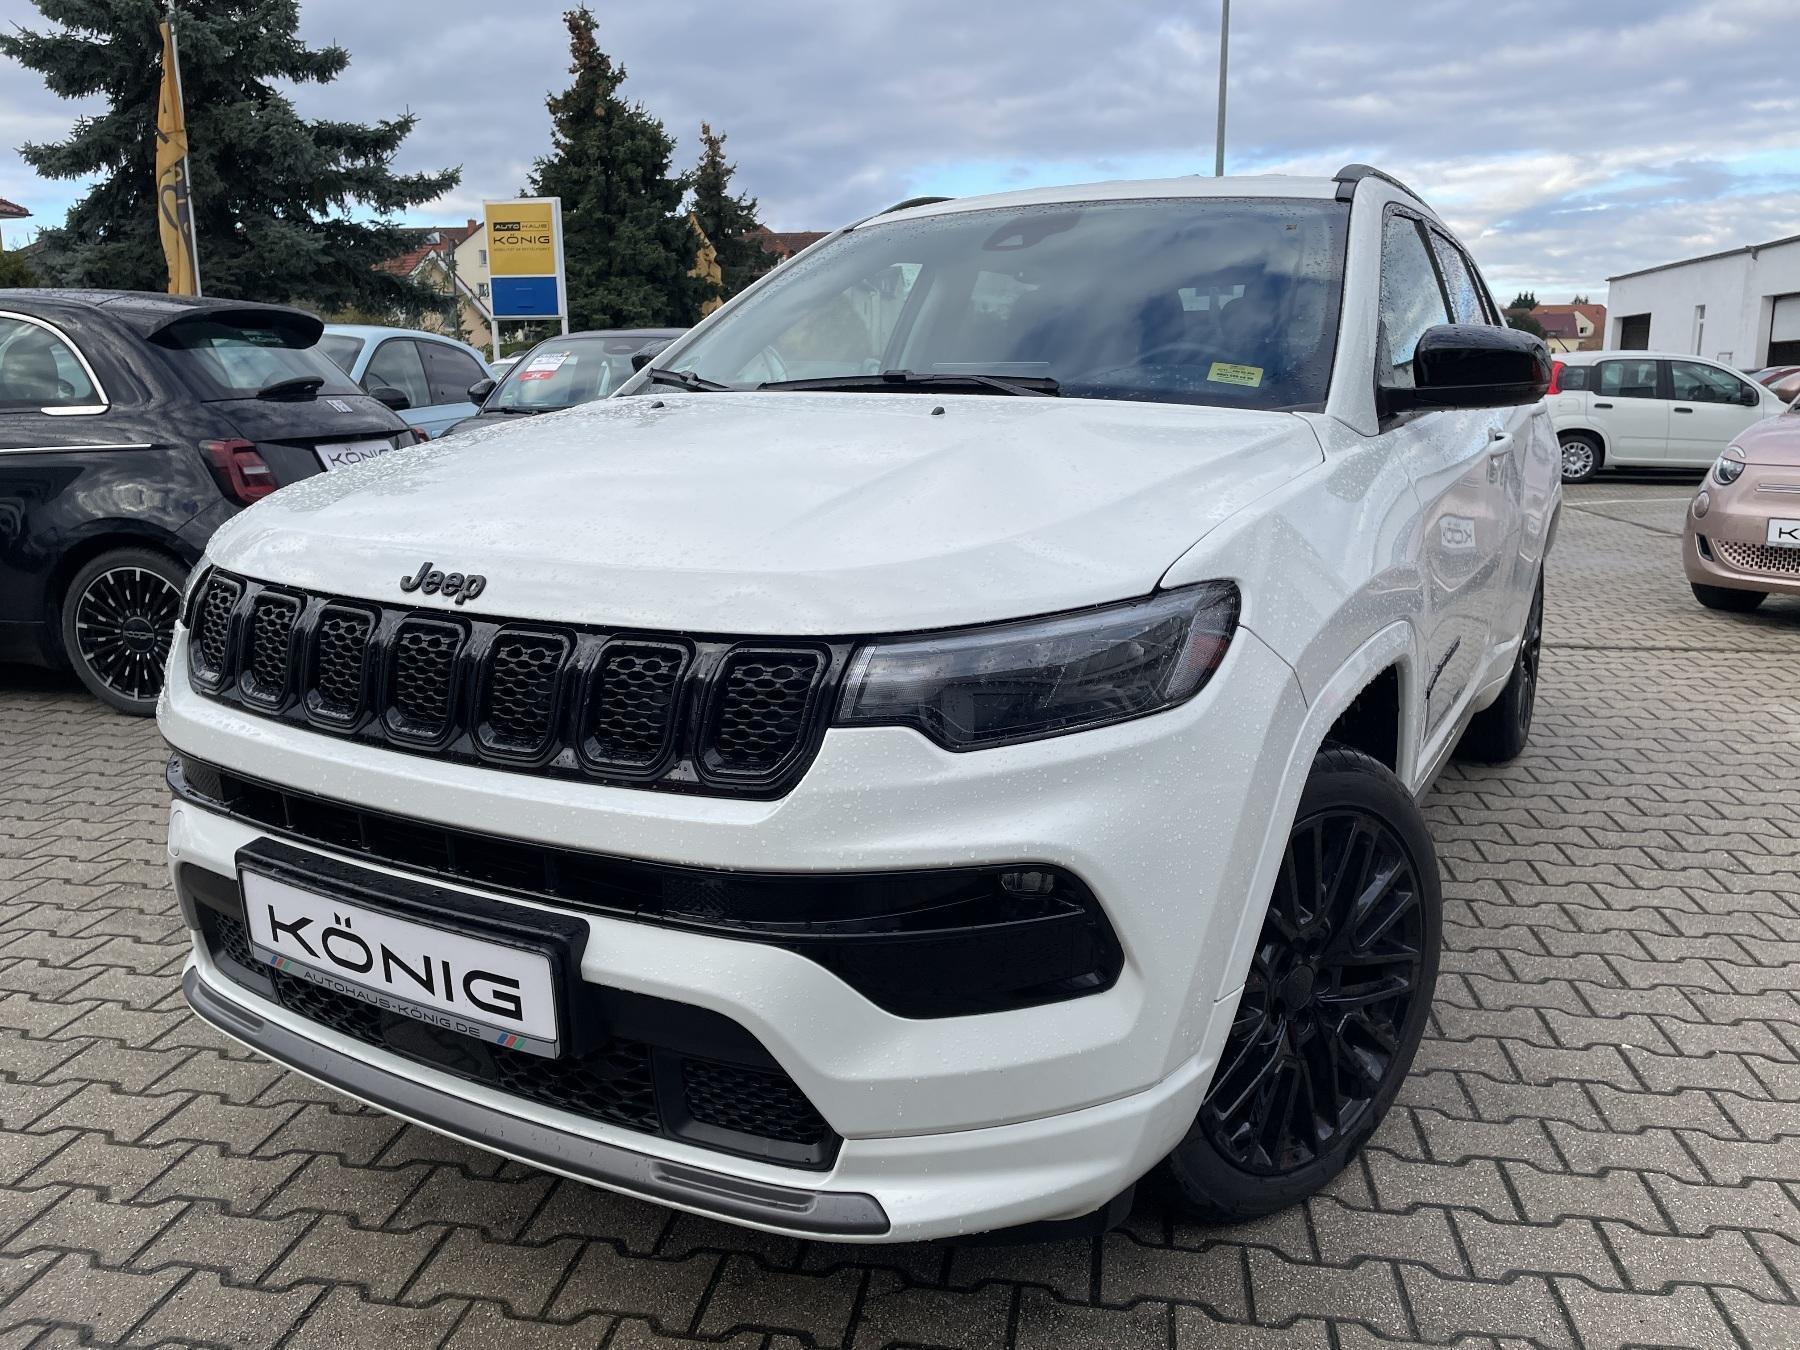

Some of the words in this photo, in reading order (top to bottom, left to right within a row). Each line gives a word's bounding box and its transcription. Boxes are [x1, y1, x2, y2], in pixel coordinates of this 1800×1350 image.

[493, 233, 550, 245] KÖNIG
[399, 561, 487, 606] Jeep
[267, 903, 524, 1022] KÖNIG
[304, 970, 481, 1038] AUTOHAUS-KÖNIG.DE
